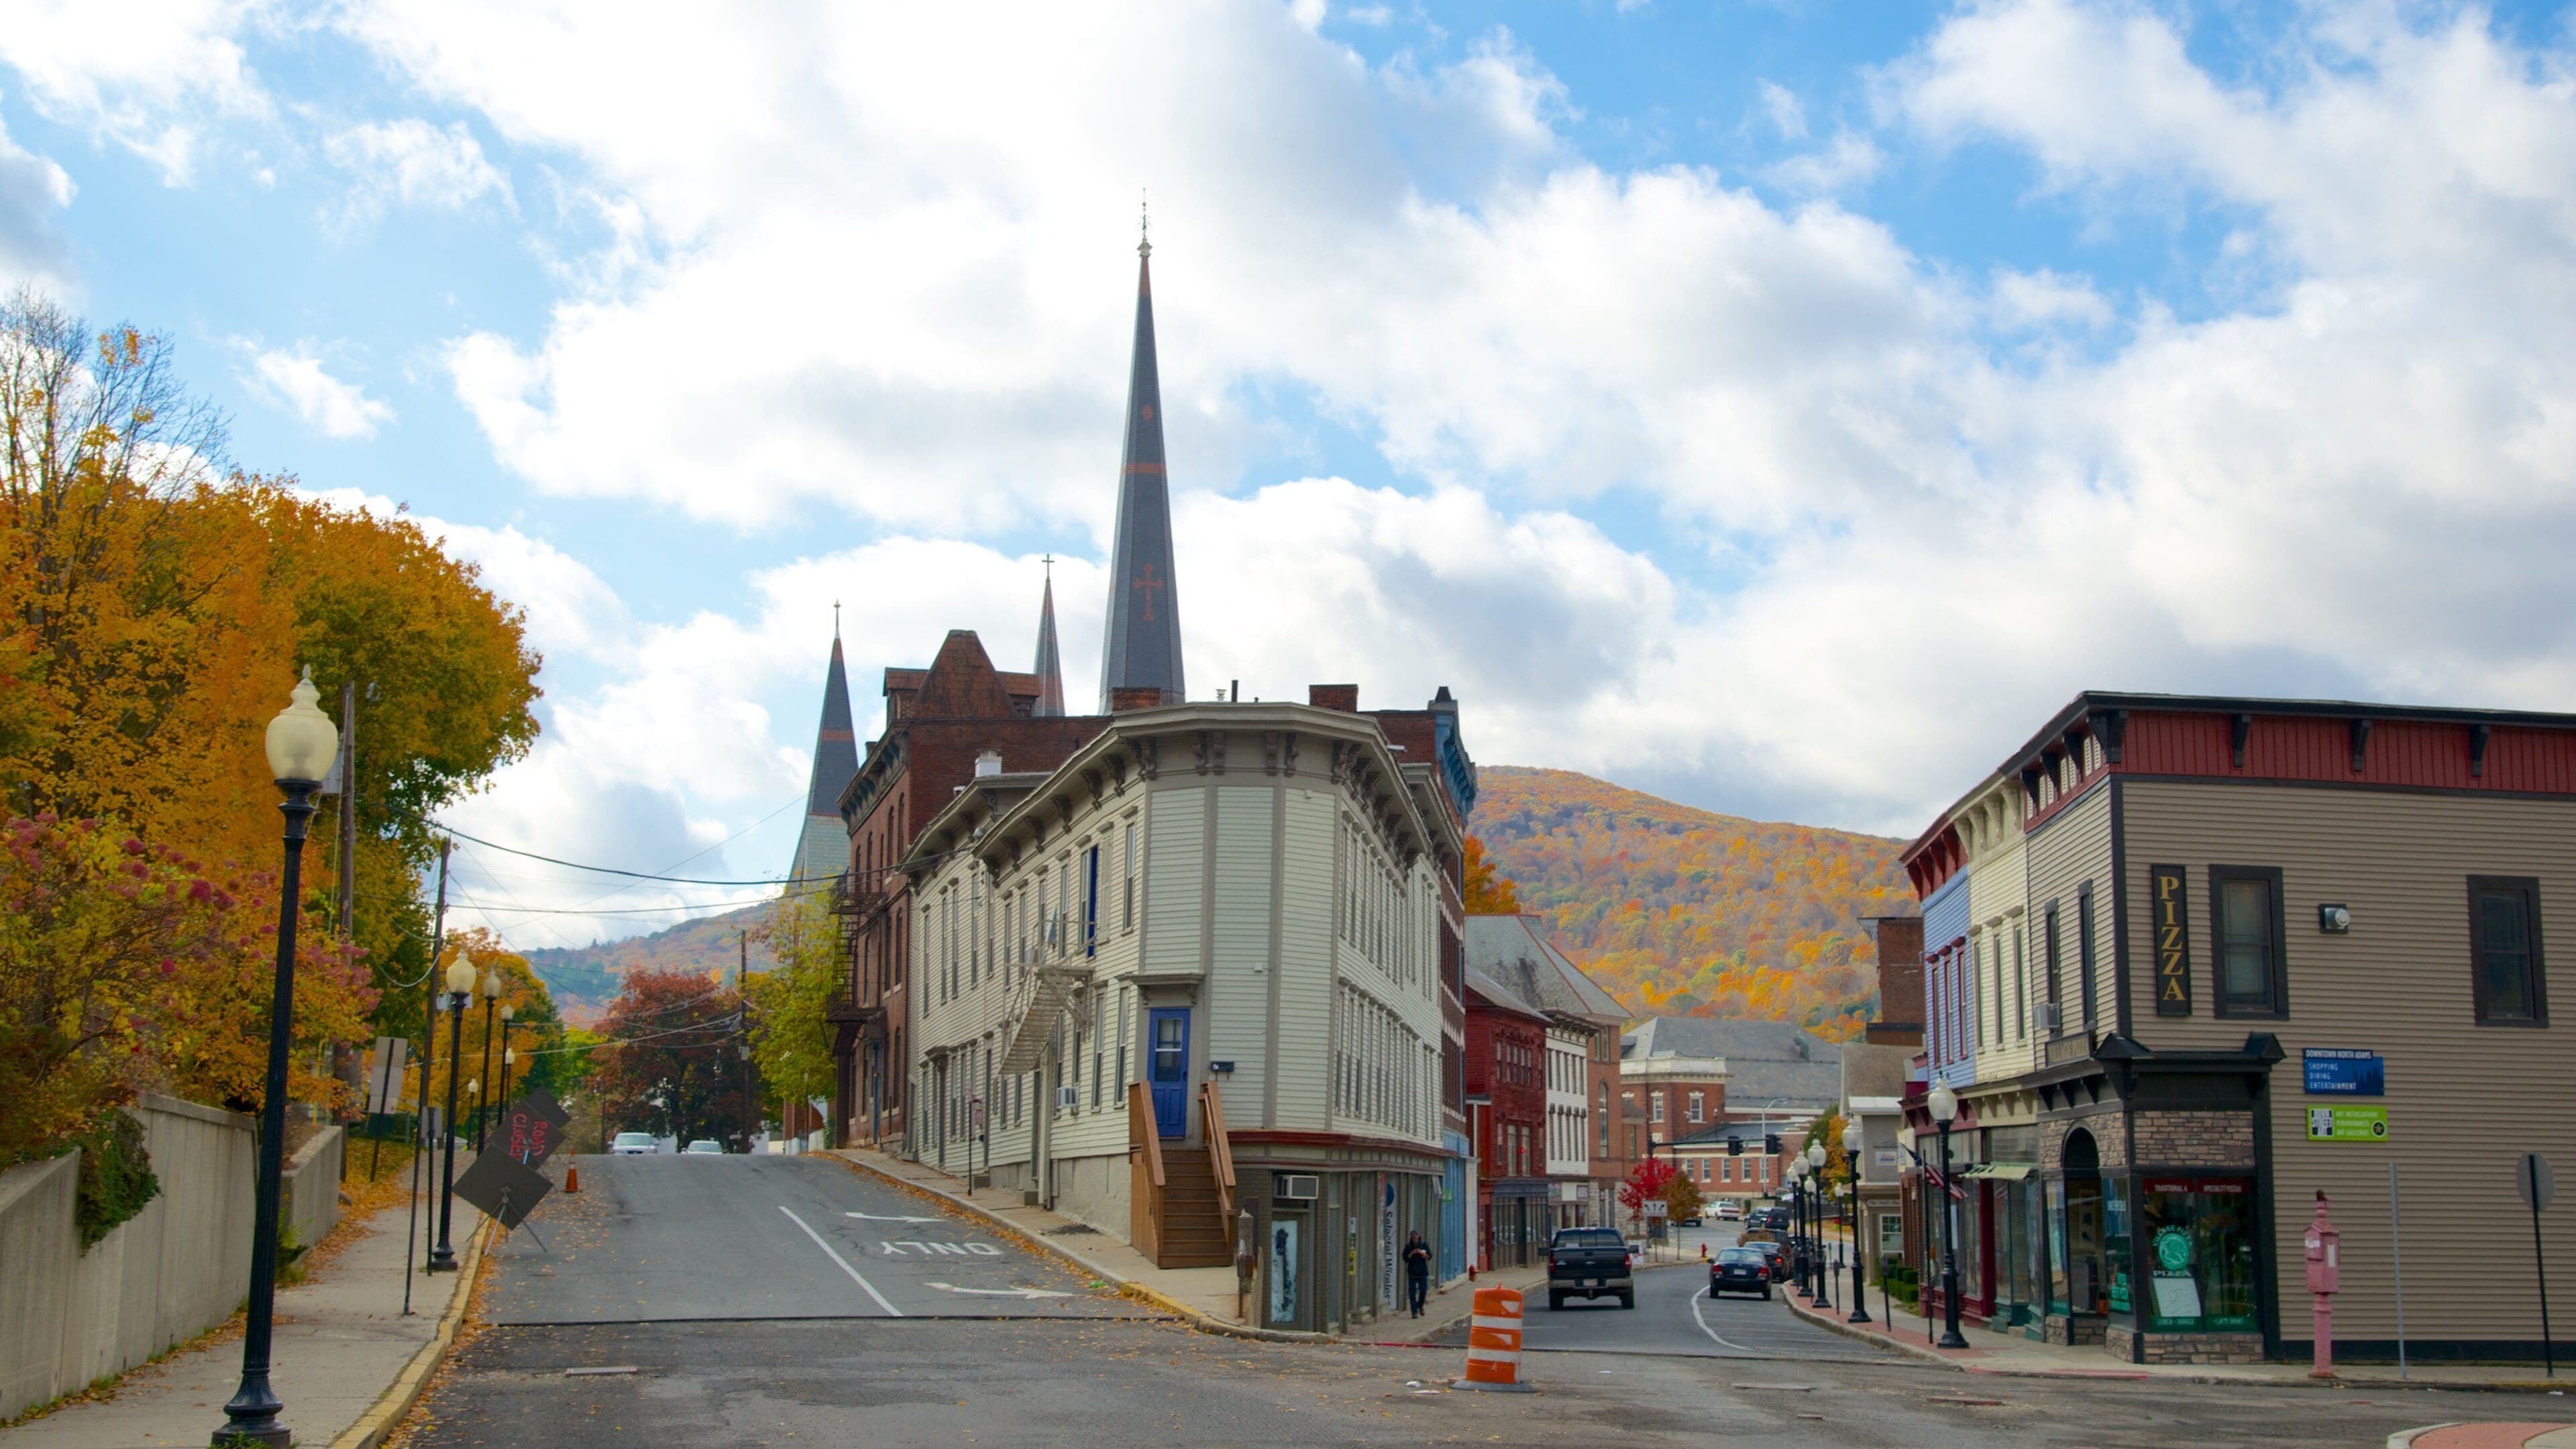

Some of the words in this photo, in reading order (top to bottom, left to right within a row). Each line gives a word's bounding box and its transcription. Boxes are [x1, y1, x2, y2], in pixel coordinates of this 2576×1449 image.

[2158, 875, 2186, 1001] PIZZA
[2305, 1049, 2337, 1058] DOWNTOWN
[2337, 1050, 2355, 1059] NORTH
[2355, 1051, 2372, 1059] ADAMS
[2308, 1063, 2339, 1071] SHOPPING
[2309, 1072, 2331, 1080] DINING
[2310, 1081, 2357, 1090] ENTERTAINMENT
[531, 1121, 548, 1156] ROAD
[880, 1241, 1004, 1255] ONLY
